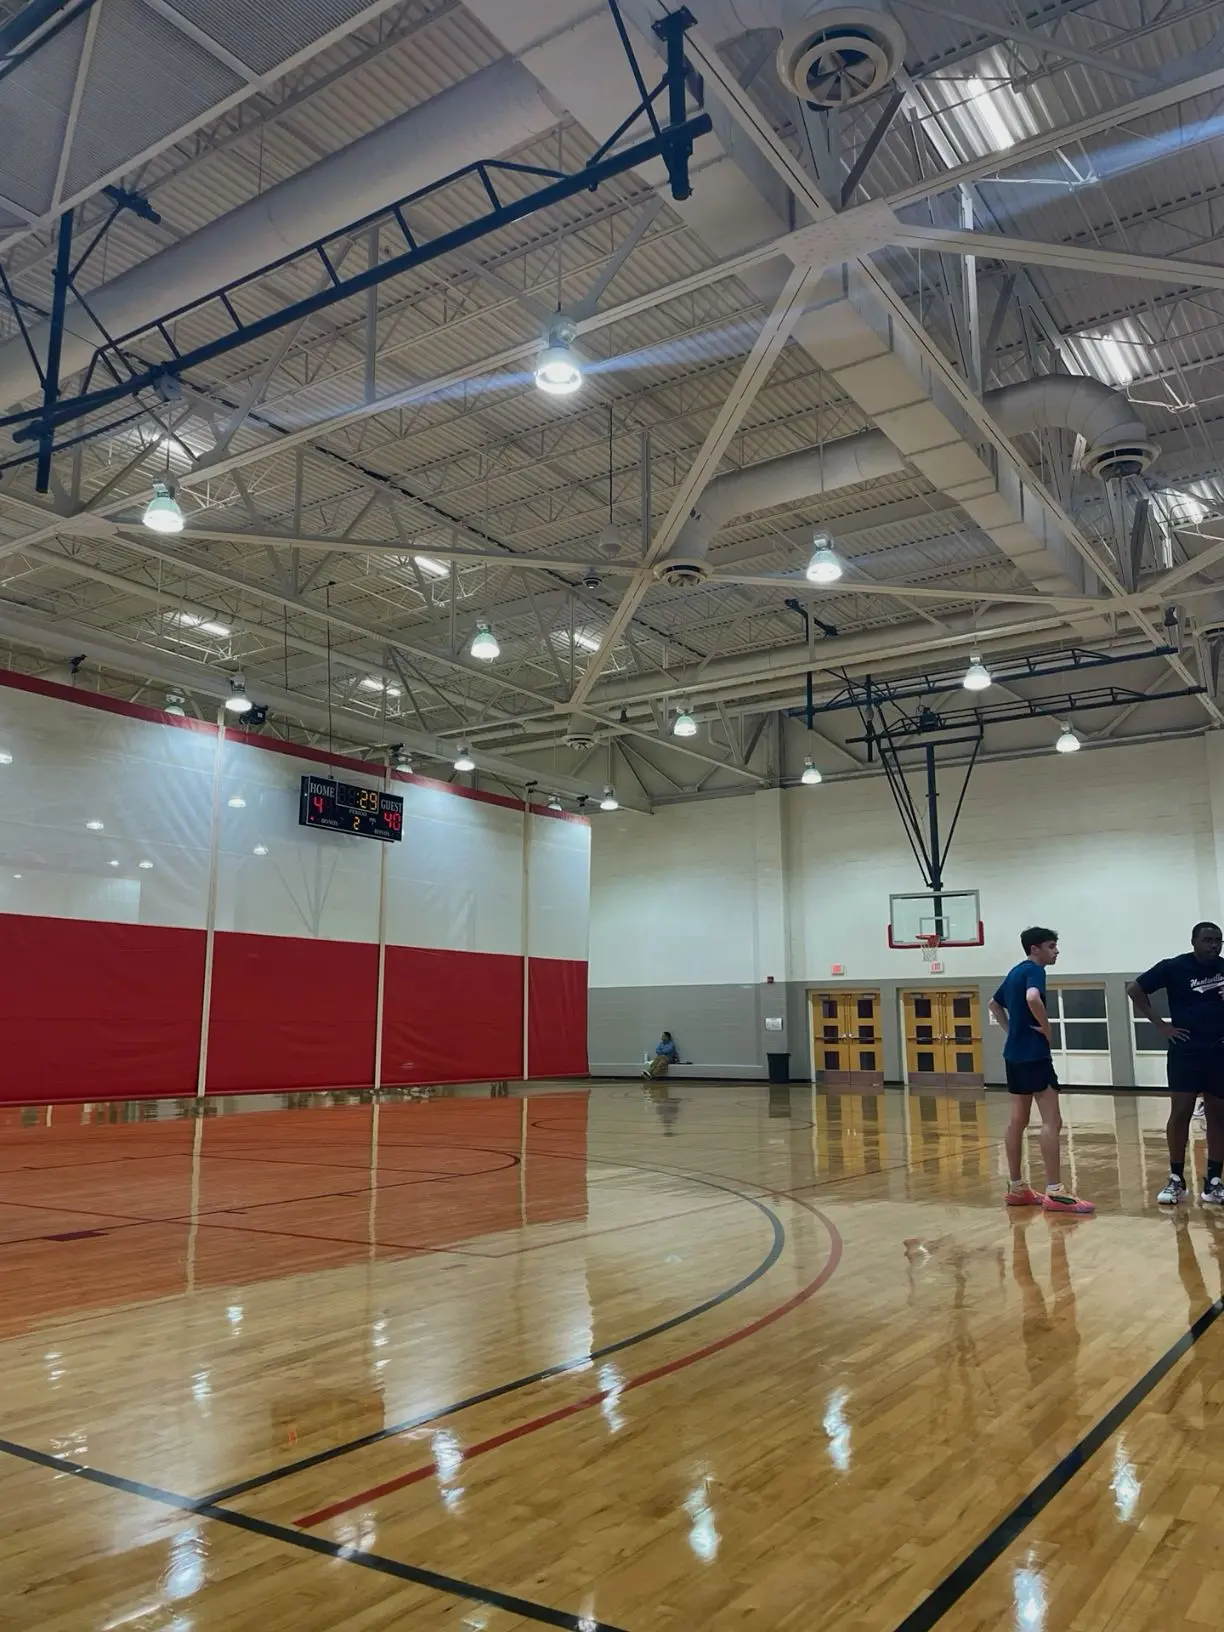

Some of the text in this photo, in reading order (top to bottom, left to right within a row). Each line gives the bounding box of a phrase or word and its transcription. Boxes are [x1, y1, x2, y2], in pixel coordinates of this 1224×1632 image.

[310, 782, 335, 798] HOME
[313, 796, 323, 814] 4
[381, 799, 403, 813] GUEST
[353, 815, 361, 830] 2
[384, 811, 401, 831] 40
